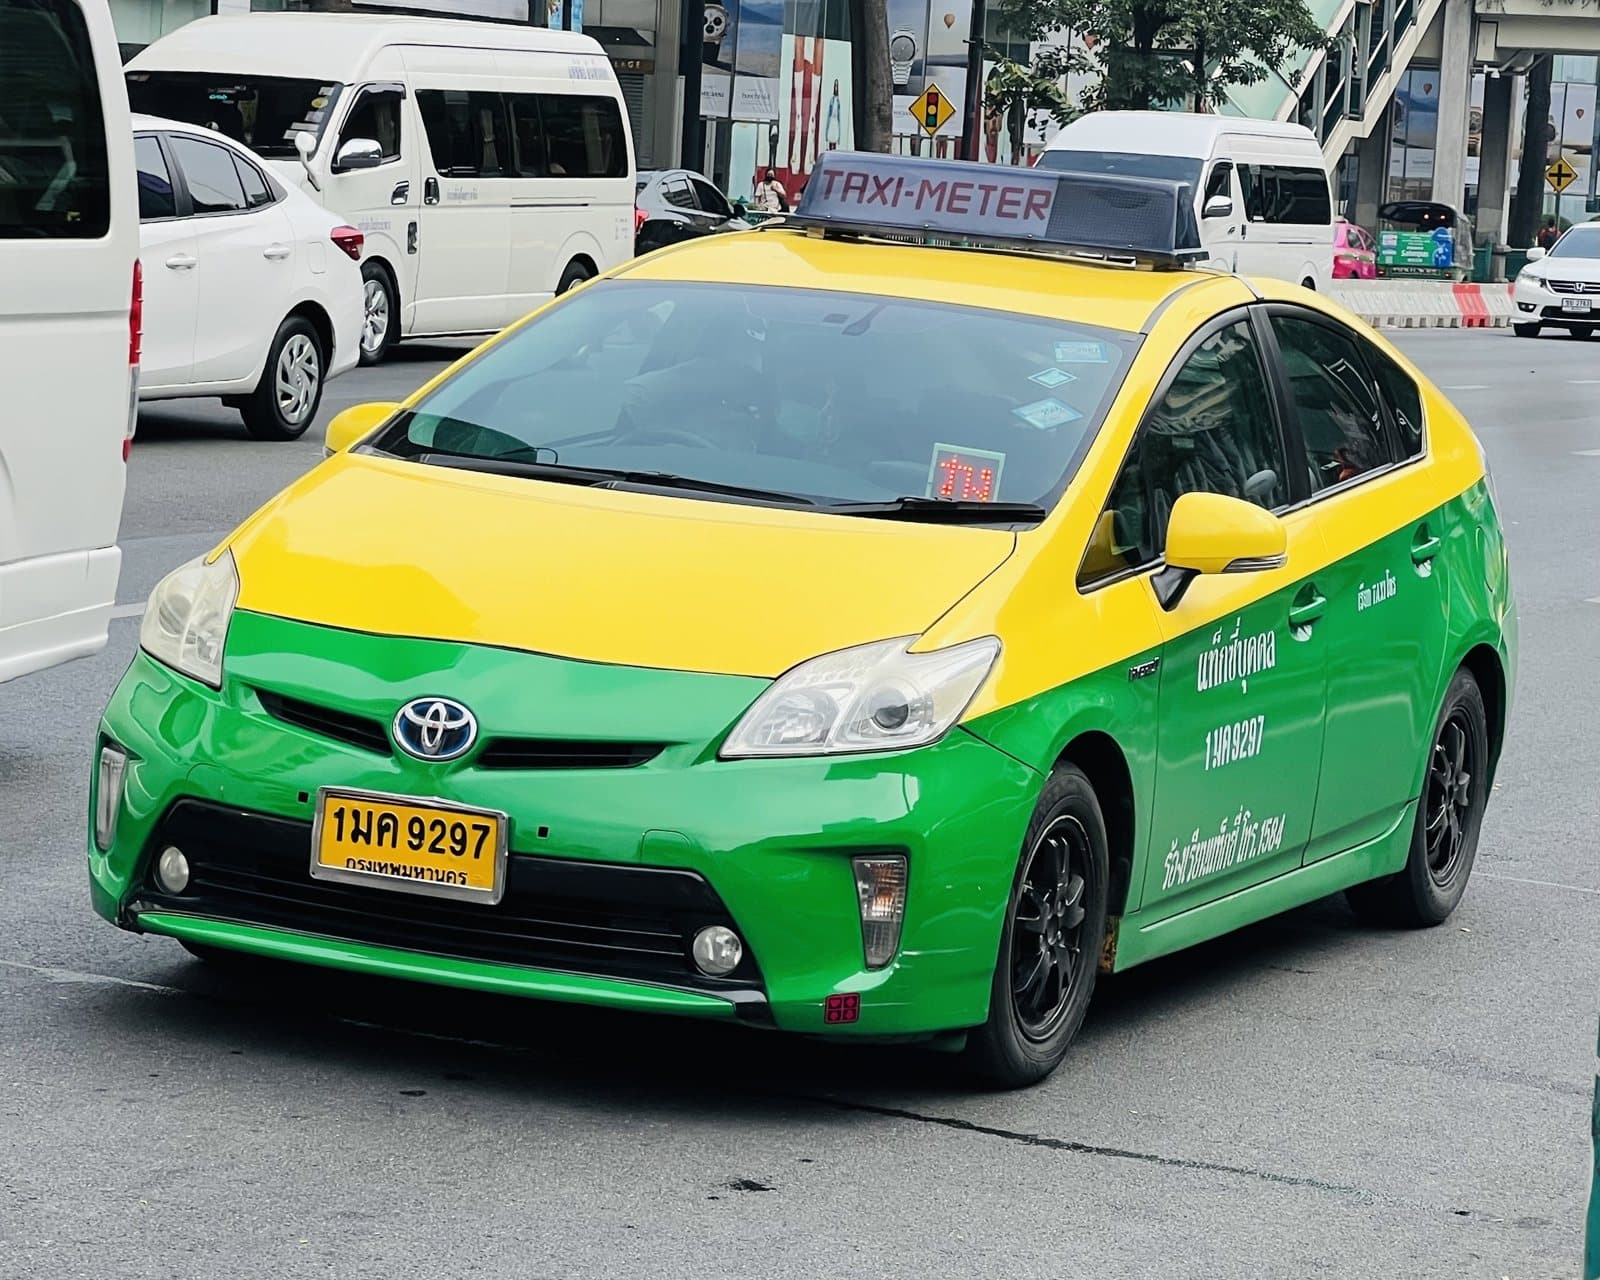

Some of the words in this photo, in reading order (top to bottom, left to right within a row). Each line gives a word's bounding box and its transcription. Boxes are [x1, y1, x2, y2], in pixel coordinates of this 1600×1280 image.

[823, 169, 1053, 221] TAXI-METER
[1197, 617, 1275, 694] แท็กซี่บุคคล
[333, 807, 398, 849] 1มค
[407, 816, 490, 859] 9297
[345, 857, 468, 885] กรงเทพมหานคร
